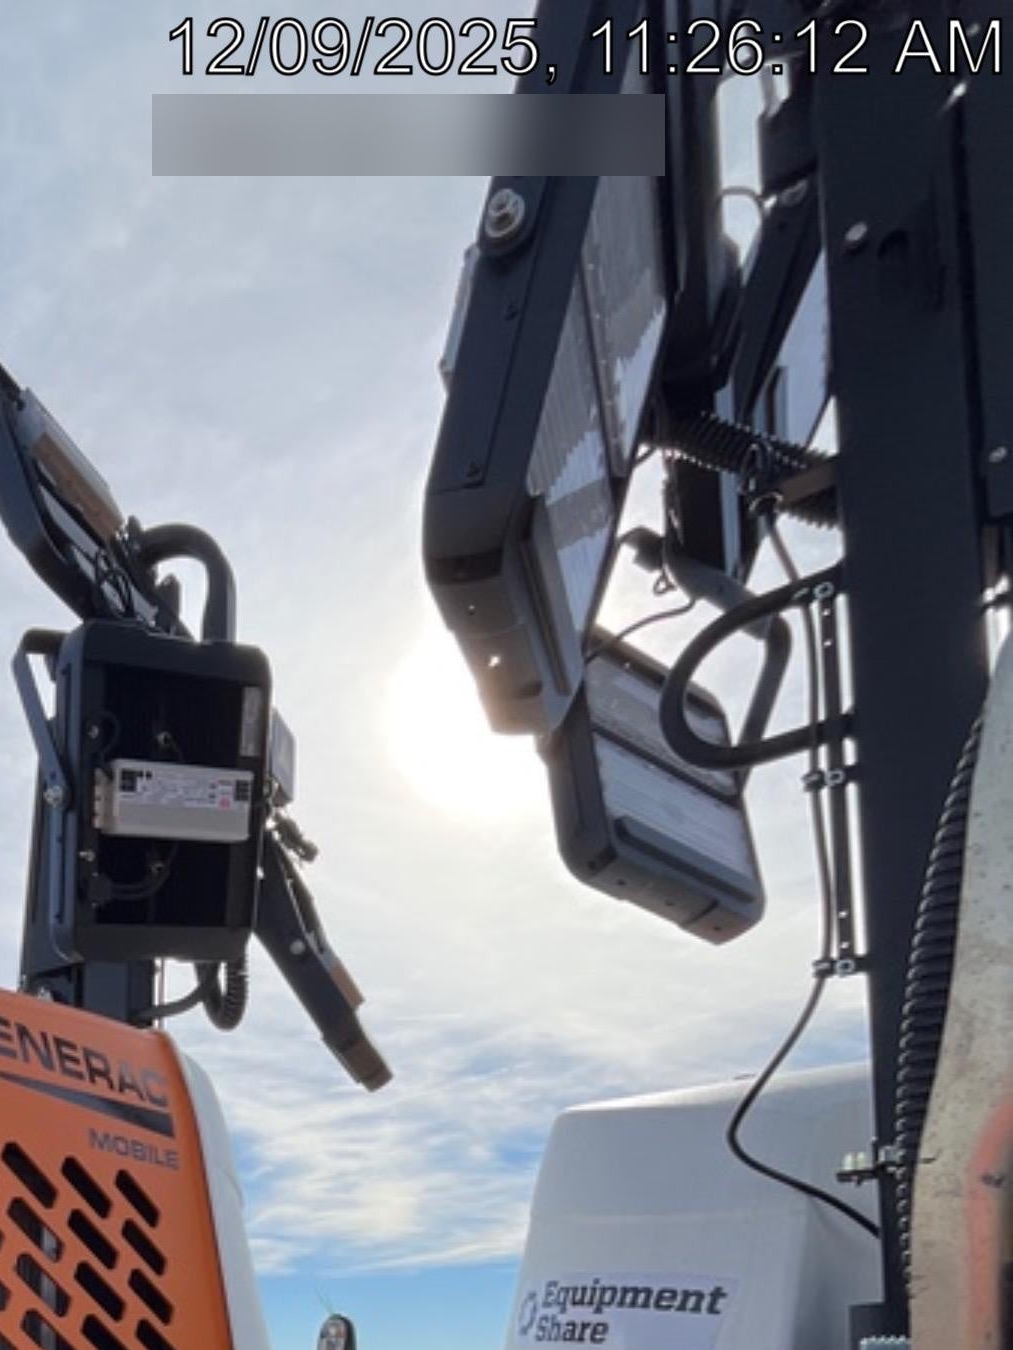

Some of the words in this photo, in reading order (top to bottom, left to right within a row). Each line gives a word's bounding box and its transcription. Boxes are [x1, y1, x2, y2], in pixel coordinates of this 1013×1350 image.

[89, 1128, 179, 1170] MOBILE
[541, 1278, 728, 1315] Equipment
[535, 1315, 610, 1344] Share
